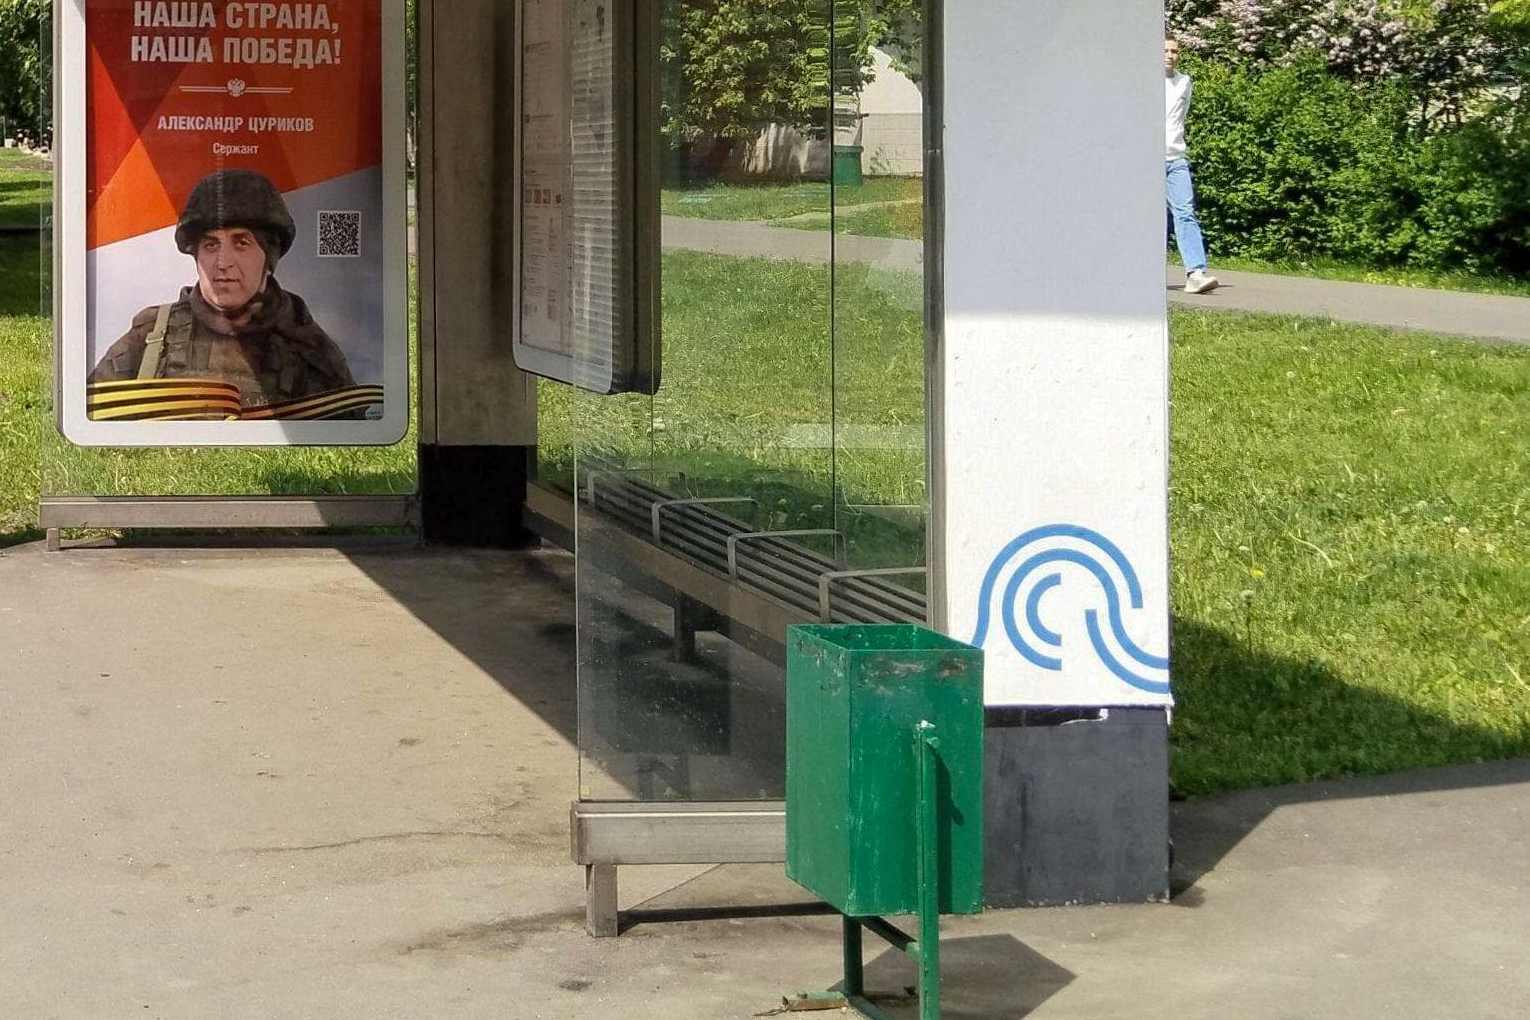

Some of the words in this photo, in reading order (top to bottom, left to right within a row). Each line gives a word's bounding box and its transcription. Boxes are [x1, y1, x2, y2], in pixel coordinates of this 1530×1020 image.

[133, 1, 216, 28] НАША
[225, 2, 339, 35] СТРАНА,
[130, 36, 214, 63] НАША
[223, 37, 341, 69] ПОБЕДА!
[157, 115, 243, 133] АЛЕКСАНДР
[248, 117, 314, 134] ЦУРИКОВ
[212, 142, 259, 157] Сержант
